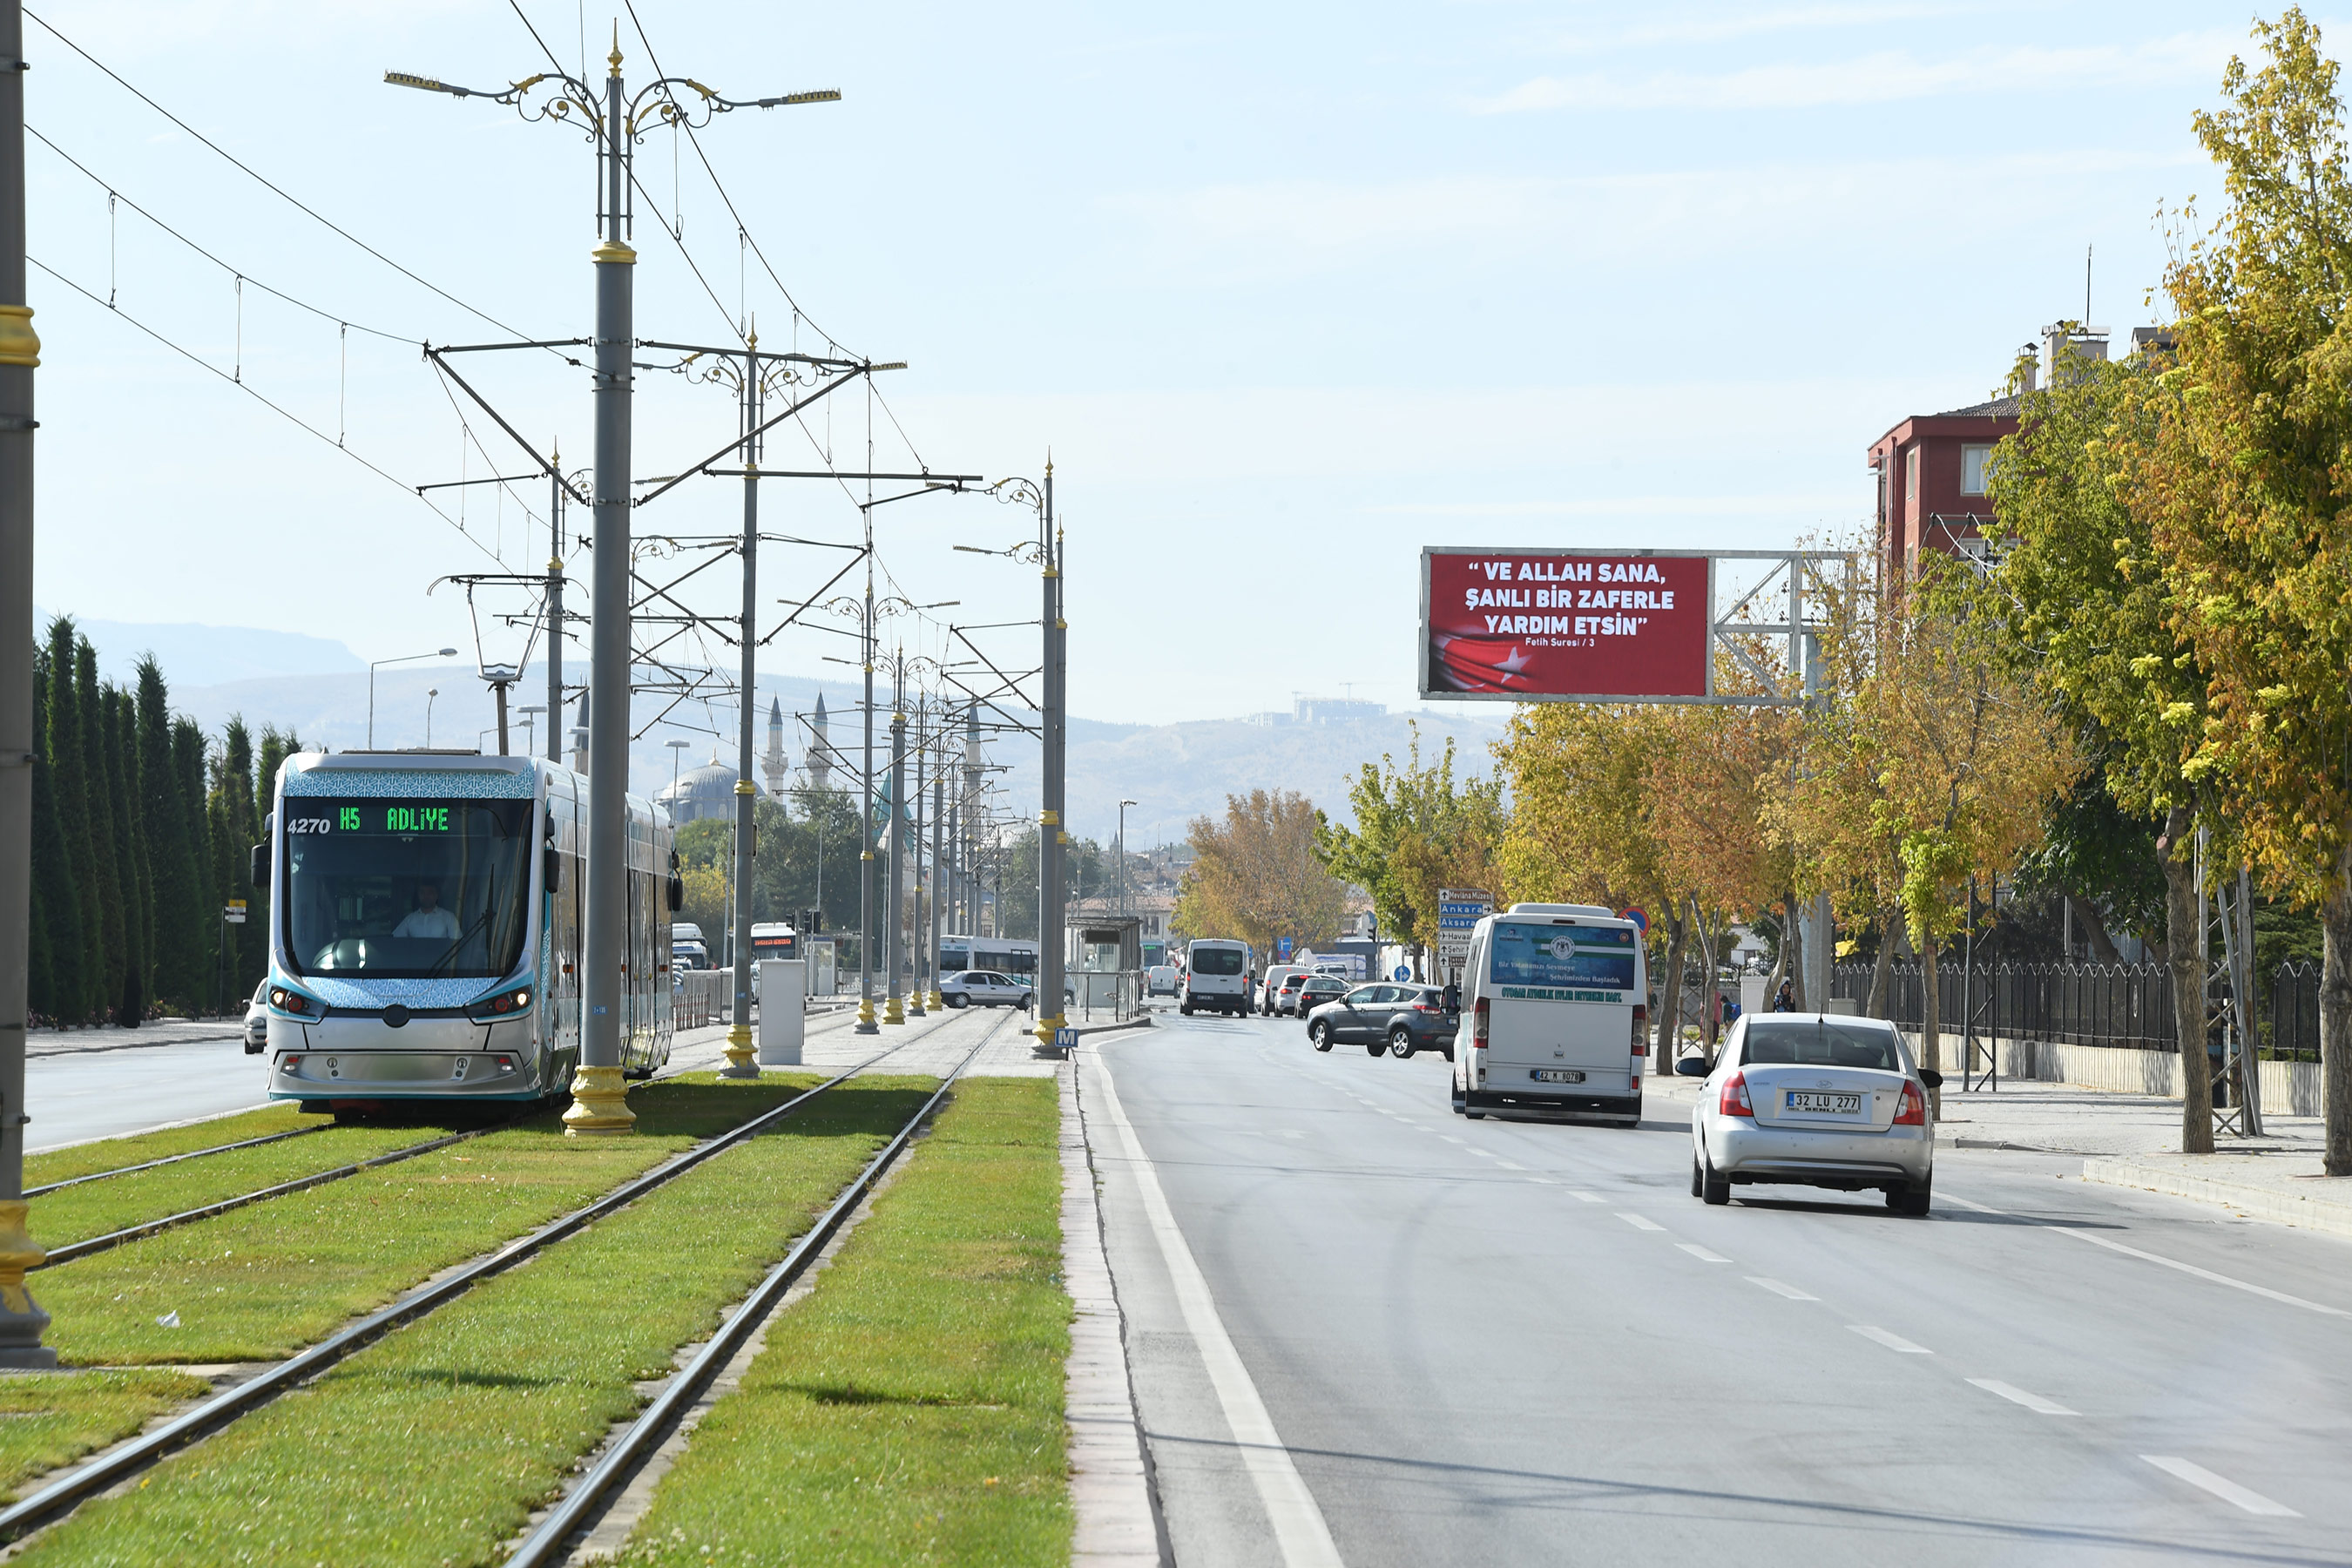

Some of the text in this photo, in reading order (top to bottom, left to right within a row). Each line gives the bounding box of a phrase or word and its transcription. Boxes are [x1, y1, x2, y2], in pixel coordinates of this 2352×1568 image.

[1484, 562, 1512, 581] VE
[1517, 562, 1592, 582] ALLAH
[1597, 563, 1666, 585] SANA,
[1464, 584, 1675, 611] ŞANLI BİR ZAFERLE
[1484, 614, 1569, 634] YARDIM
[1525, 637, 1549, 647] Fetih
[1551, 637, 1580, 647] Suresi
[1589, 638, 1595, 647] 3
[287, 818, 331, 835] 4270
[339, 807, 361, 830] H5
[1441, 918, 1476, 927] Aksara
[1448, 945, 1465, 954] Şehir
[1058, 1030, 1075, 1045] M
[1796, 1094, 1857, 1109] 32 LU 277
